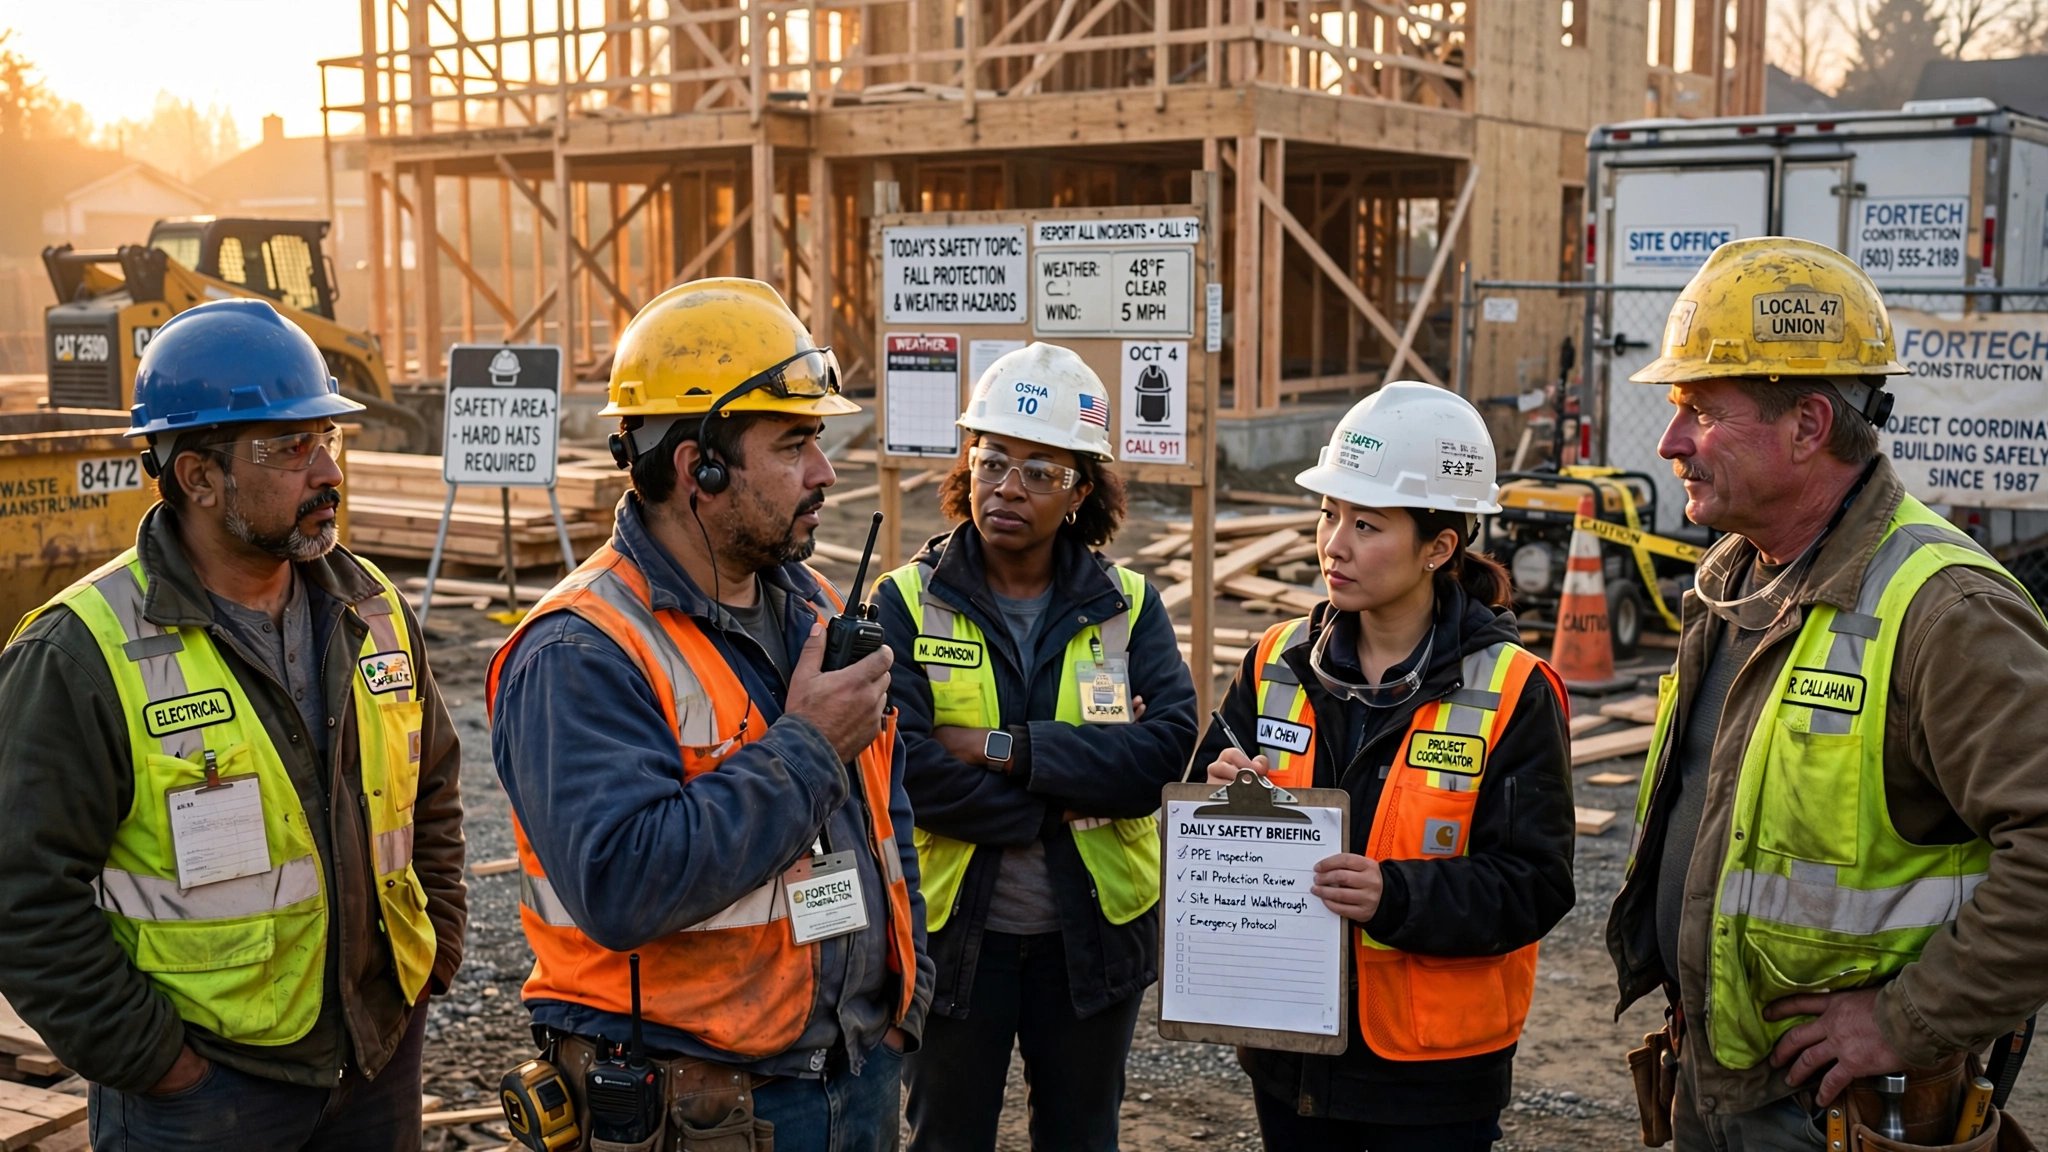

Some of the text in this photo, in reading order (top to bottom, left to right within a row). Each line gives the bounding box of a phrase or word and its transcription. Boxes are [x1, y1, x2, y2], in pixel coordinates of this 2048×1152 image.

[1865, 203, 1963, 225] FORTECH
[1040, 224, 1075, 241] REPORT
[1078, 224, 1095, 240] ALL
[1097, 223, 1147, 240] INCIDENTS
[1158, 222, 1181, 238] CALL
[1630, 231, 1665, 251] SITE
[1862, 228, 1960, 241] CONSTRUCTION
[890, 236, 1022, 258] TODAY'S SAFETY TOPIC:
[1129, 258, 1165, 277] 48°F
[1861, 247, 1959, 272] (503) 555-2189
[903, 265, 1006, 285] FALL PROTECTION
[1043, 261, 1100, 278] WEATHER:
[1125, 280, 1167, 297] CLEAR
[894, 292, 1017, 312] & WEATHER HAZARDS
[1046, 303, 1082, 320] WIND:
[1760, 299, 1838, 316] LOCAL 47
[1121, 303, 1166, 322] 5 MPH
[1772, 318, 1825, 335] UNION
[55, 334, 76, 361] CAT
[1129, 346, 1178, 361] OCT 4
[1901, 329, 2048, 361] FORTECH
[1907, 361, 2043, 381] CONSTRUCTION
[1015, 382, 1048, 398] OSHA
[454, 397, 548, 418] SAFETY AREA
[1017, 396, 1038, 415] 10
[461, 425, 541, 445] HARD HATS
[1882, 416, 2048, 440] OJECT COORDINA
[1125, 439, 1180, 456] CALL 911
[1351, 433, 1384, 452] SAFETY
[1893, 441, 1977, 463] BUILDING
[465, 452, 536, 473] REQUIRED
[1442, 459, 1483, 477] 安全第一
[81, 459, 139, 489] 8472
[1928, 468, 2040, 492] SINCE 1987
[0, 478, 59, 498] WASTE
[1581, 519, 1642, 544] CAUTION
[919, 643, 974, 662] M. JOHNSON
[1787, 676, 1855, 703] R. CALLAHAN
[155, 699, 225, 727] ELECTRICAL
[1274, 726, 1299, 744] CHEN
[1428, 738, 1467, 754] PROJECT
[1180, 823, 1321, 842] DAILY SAFETY BRIEFING
[1190, 848, 1264, 865] PPE Inspection
[1190, 870, 1296, 886] Fall Protection Review
[805, 879, 852, 901] FORTECH
[1190, 892, 1308, 913] Site Hazard Walkthrough
[1190, 914, 1277, 932] Emergency Protocol
